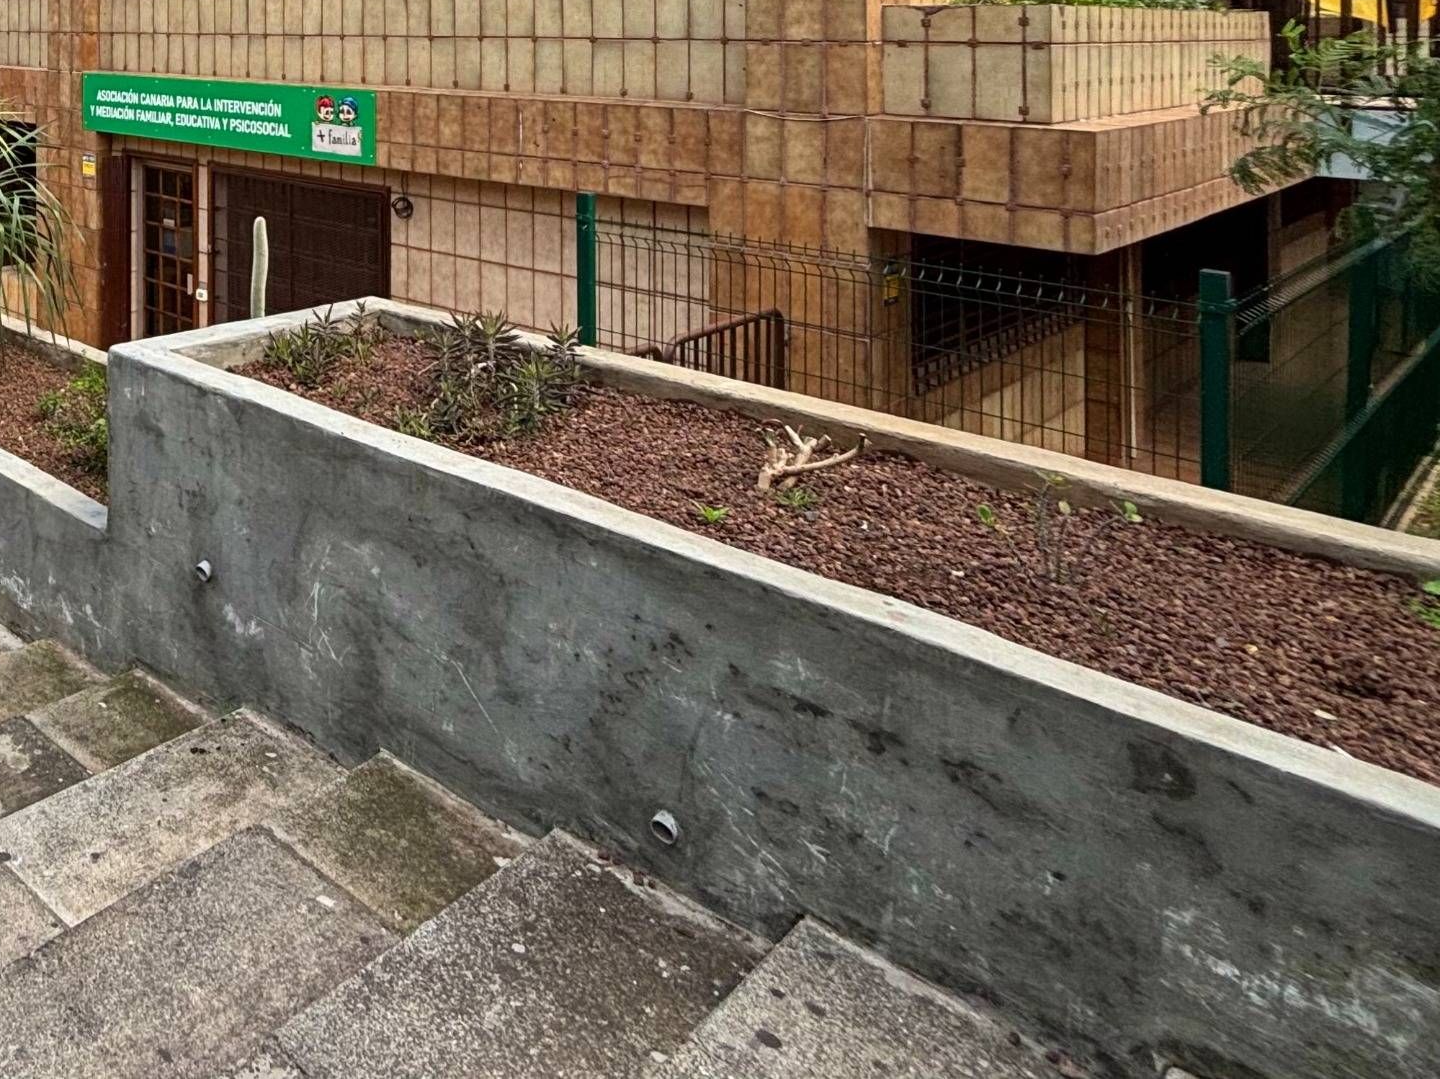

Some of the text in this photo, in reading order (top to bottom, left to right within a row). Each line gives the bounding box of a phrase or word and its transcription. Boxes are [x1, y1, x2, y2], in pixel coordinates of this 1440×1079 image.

[96, 89, 282, 117] ASOCIACIÓN CANARIA PARA LA INTERVENCIÓN
[90, 105, 95, 117] Y
[96, 105, 135, 120] MEDIACIÓN
[136, 109, 174, 127] FAMILIAR,
[175, 113, 221, 131] EDUCATIVA
[222, 118, 228, 131] Y
